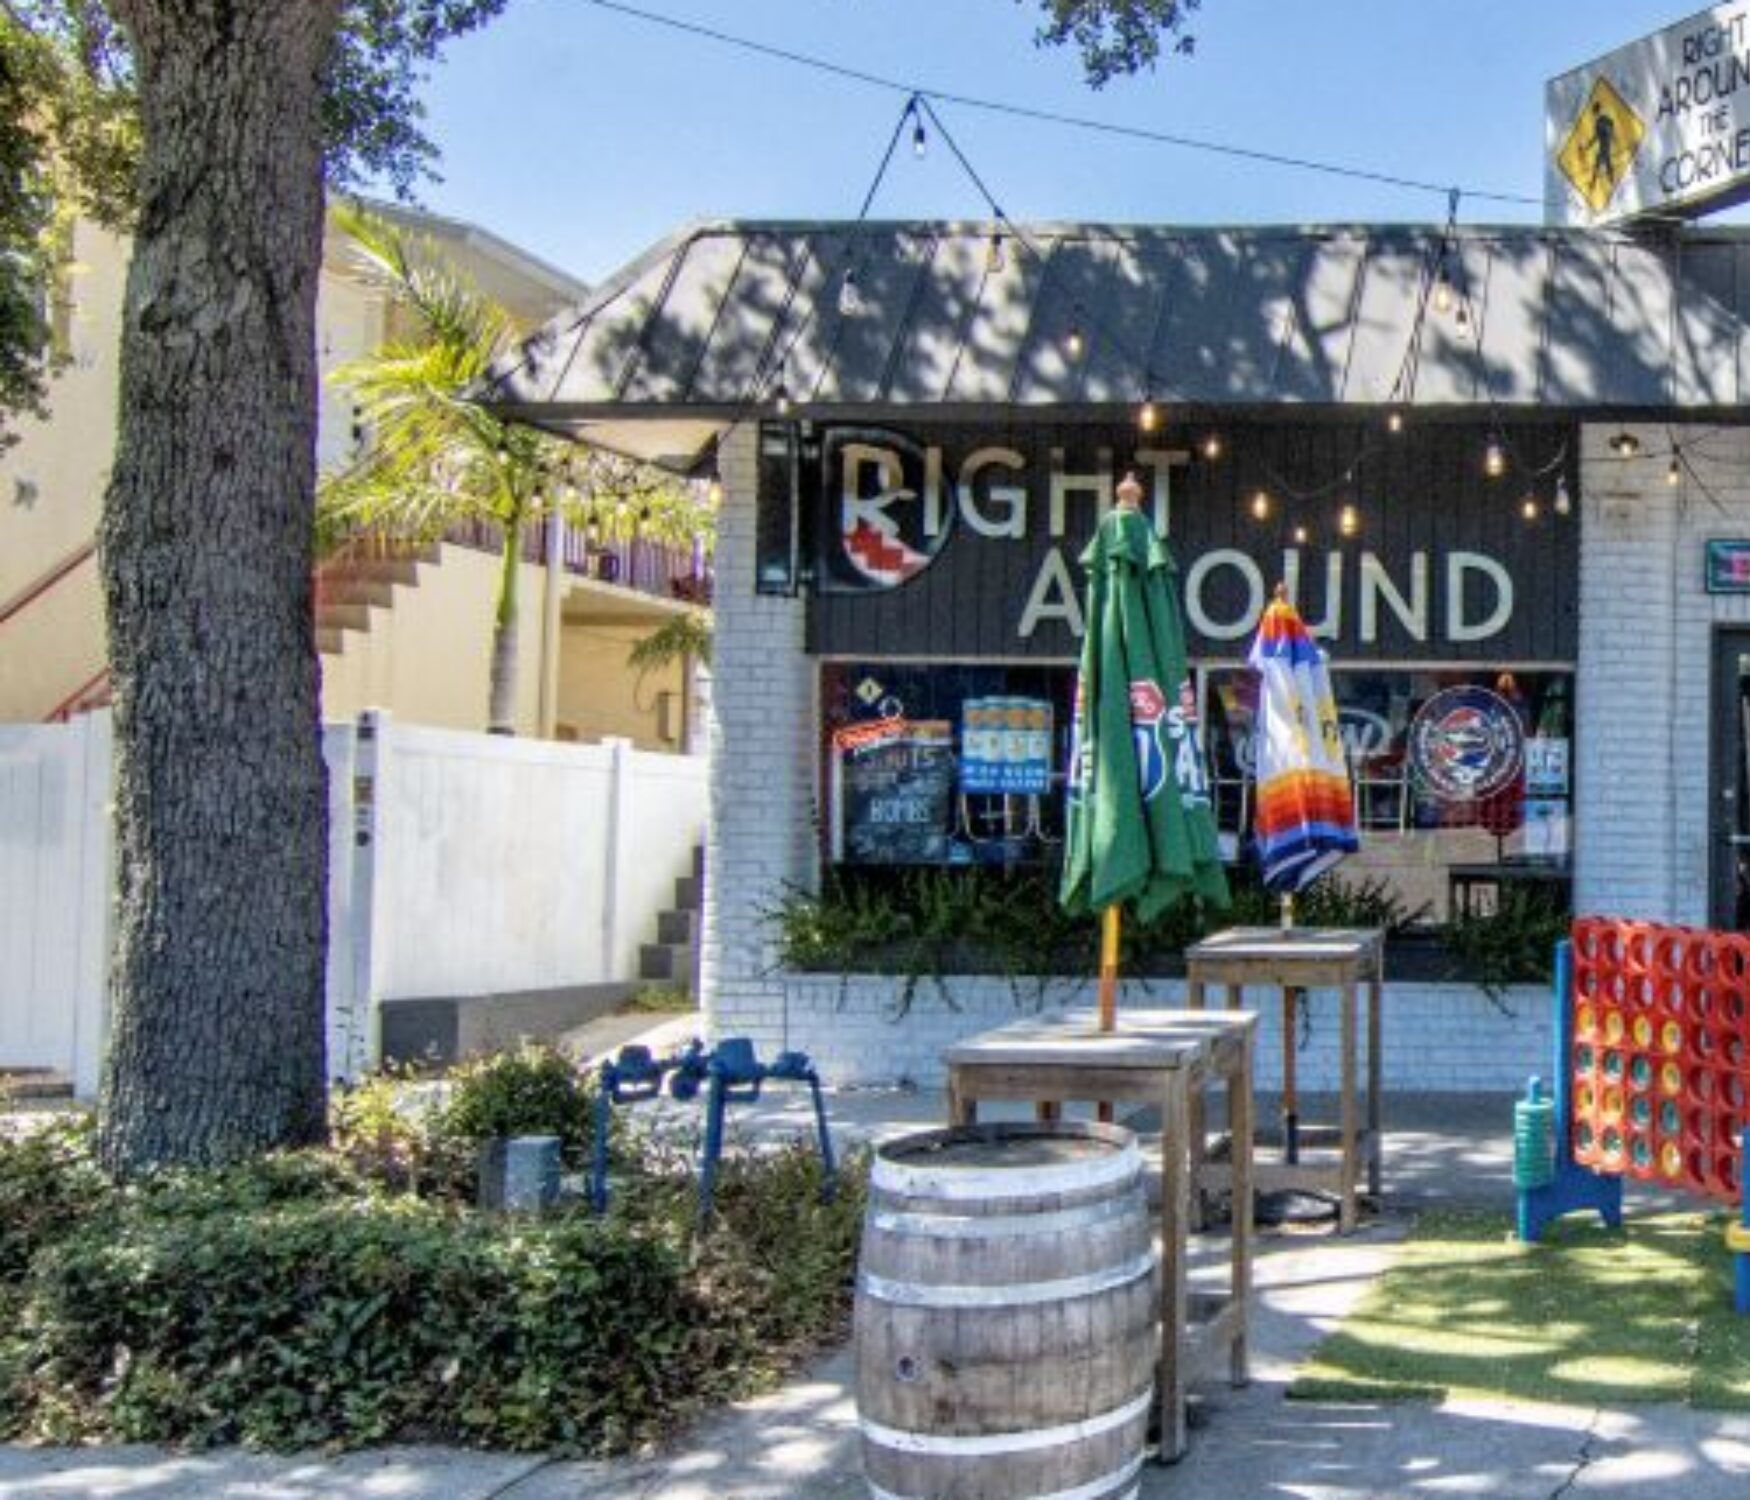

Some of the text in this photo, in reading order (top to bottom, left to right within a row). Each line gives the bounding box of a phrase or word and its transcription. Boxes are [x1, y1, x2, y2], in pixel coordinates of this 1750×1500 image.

[1683, 13, 1747, 68] RIGHT
[1699, 104, 1729, 137] THE
[841, 443, 1190, 537] RIGHT
[1017, 547, 1514, 642] AOUND
